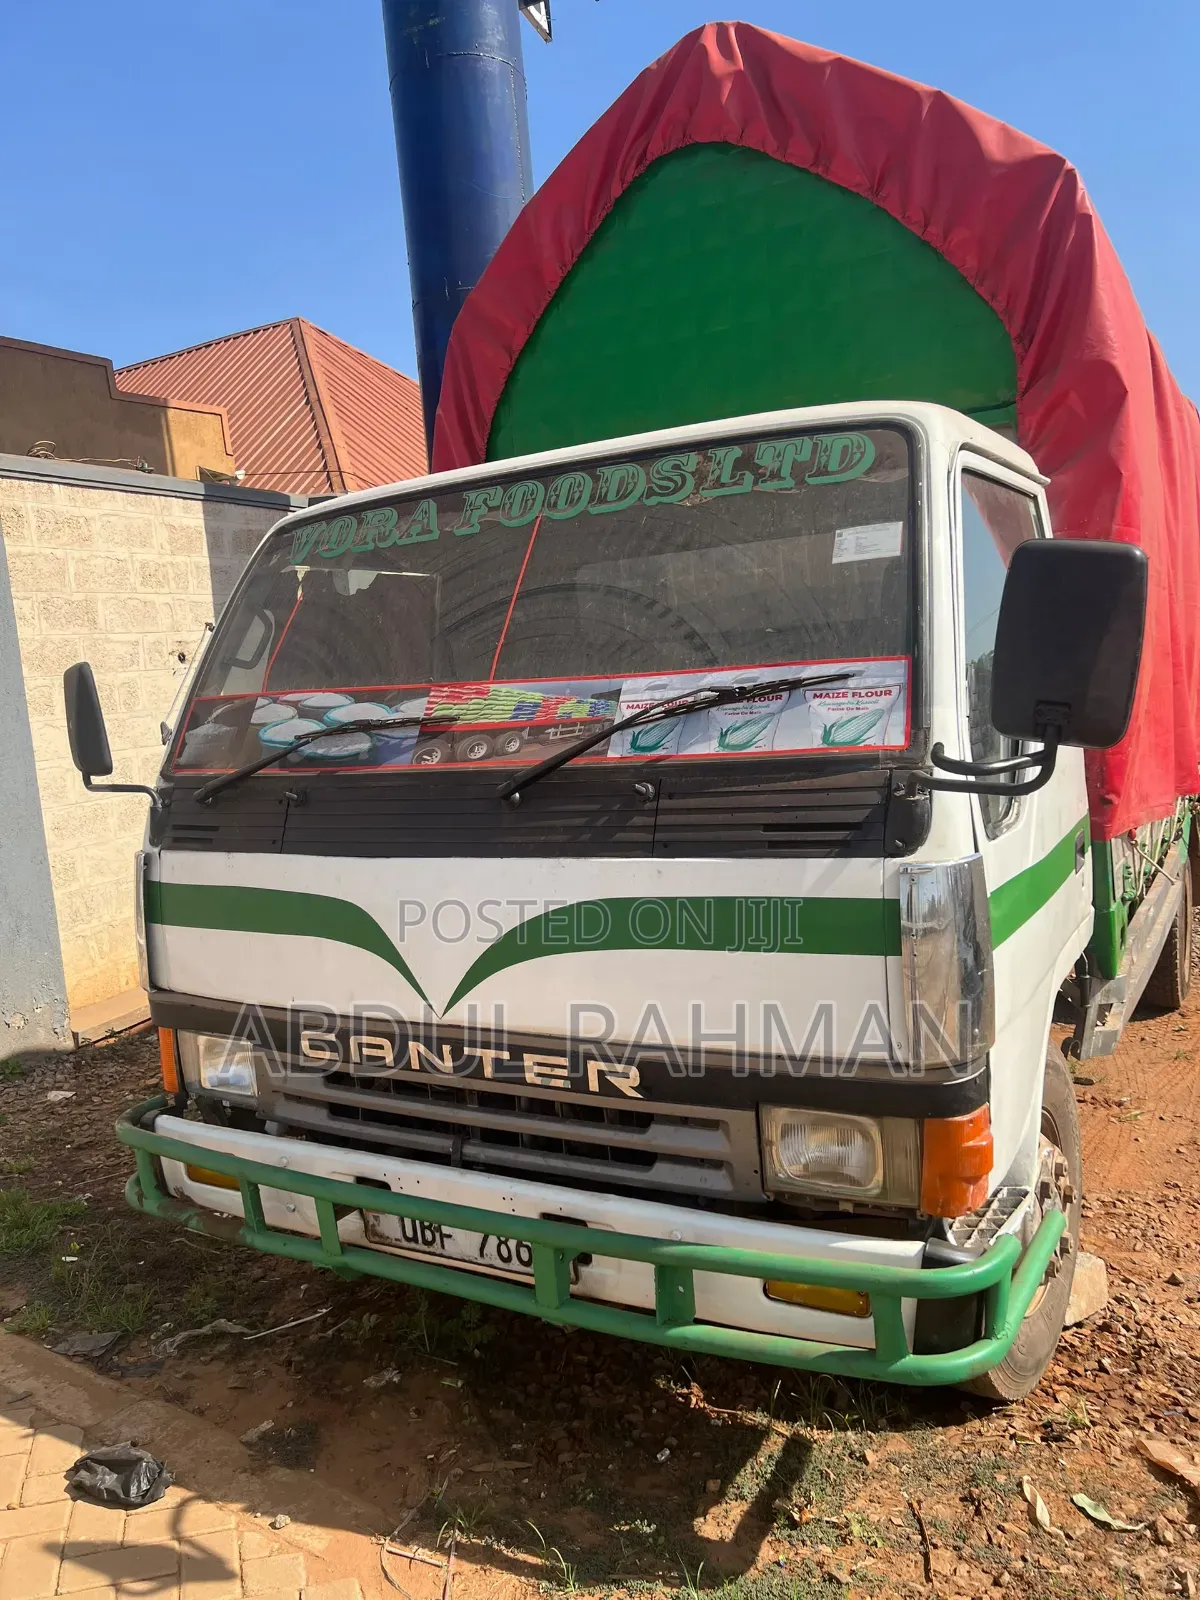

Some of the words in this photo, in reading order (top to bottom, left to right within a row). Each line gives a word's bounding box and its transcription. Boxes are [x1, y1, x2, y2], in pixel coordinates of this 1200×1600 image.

[453, 452, 698, 536] FOODS
[700, 432, 876, 497] LTD
[852, 689, 892, 698] FLOUR
